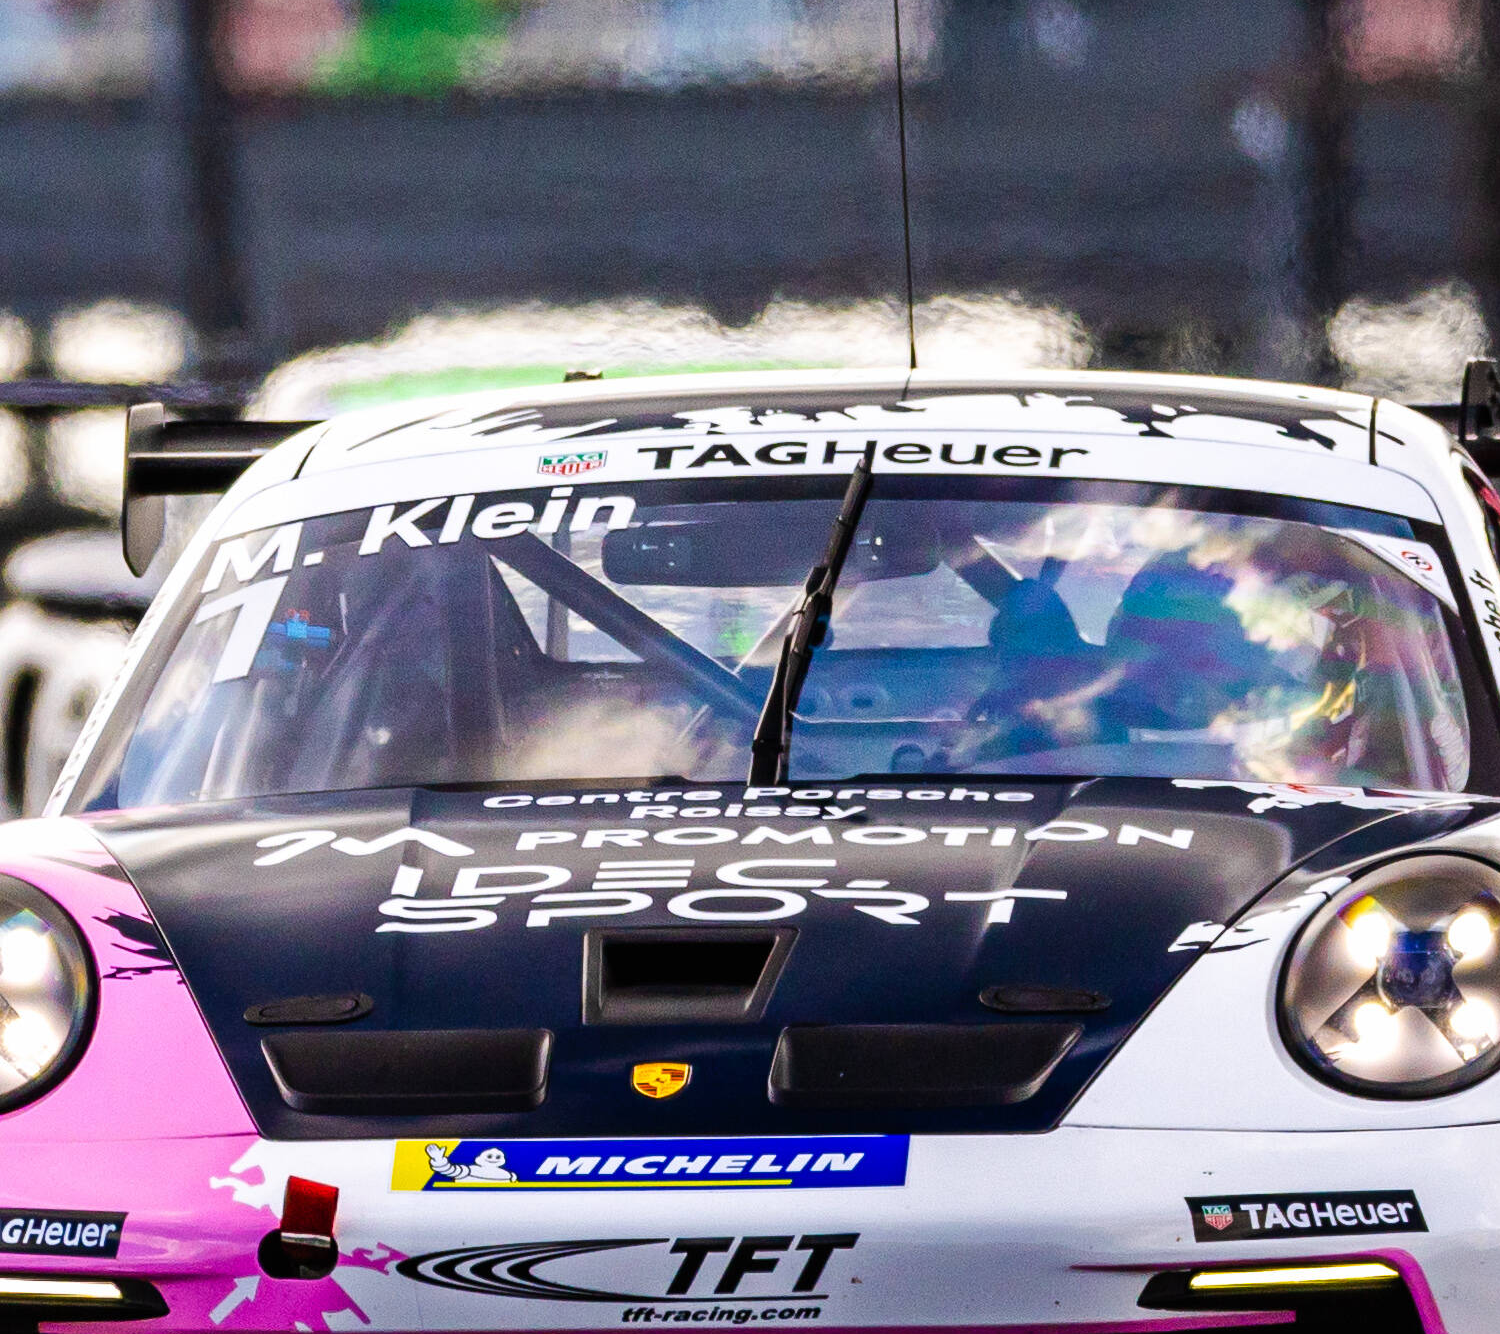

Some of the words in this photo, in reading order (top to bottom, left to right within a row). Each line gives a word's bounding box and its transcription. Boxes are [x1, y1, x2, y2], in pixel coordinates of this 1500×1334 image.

[200, 522, 325, 594] M.
[358, 487, 637, 556] Klein
[194, 575, 289, 685] 1
[483, 788, 723, 808] Centre
[742, 786, 1035, 802] Porsche
[629, 803, 867, 820] Roissy
[515, 821, 1195, 851] PROMOTION
[375, 888, 1068, 934] SPORT
[535, 1152, 865, 1175] MICHELIN
[666, 1232, 861, 1296] TFT
[621, 1304, 821, 1325] tft-racing.com
